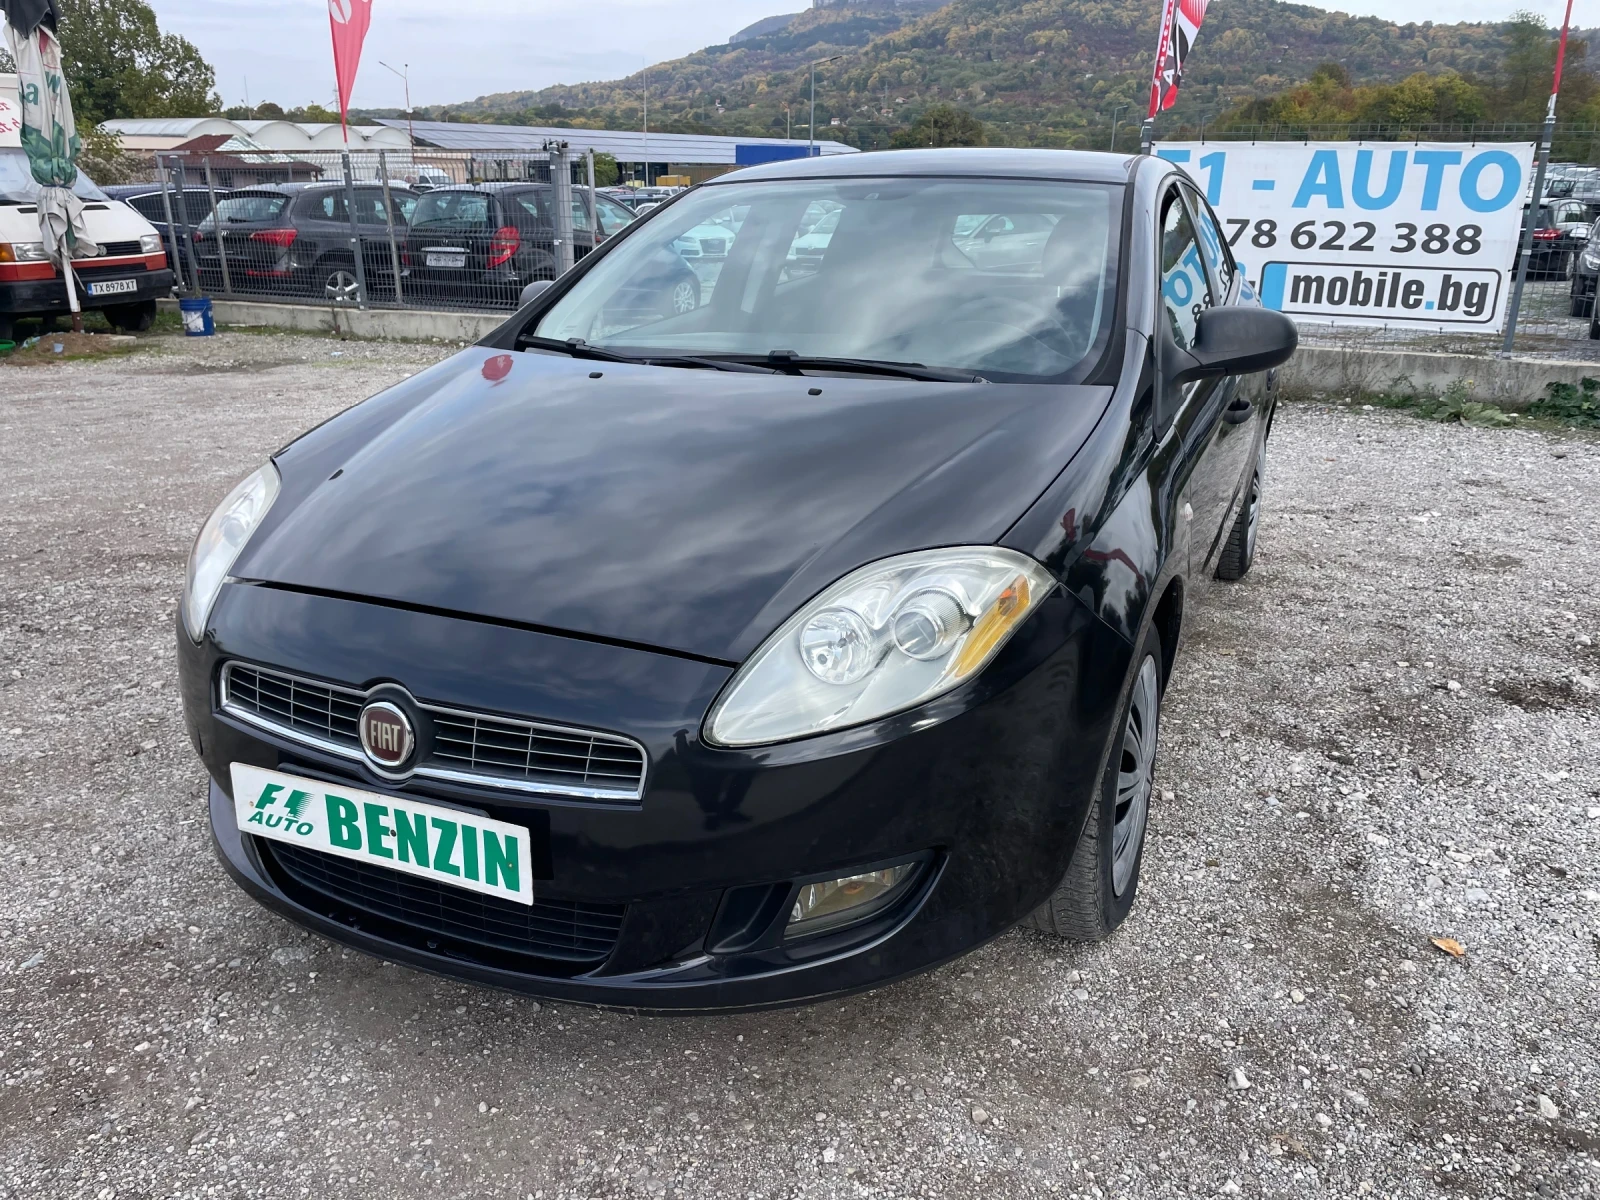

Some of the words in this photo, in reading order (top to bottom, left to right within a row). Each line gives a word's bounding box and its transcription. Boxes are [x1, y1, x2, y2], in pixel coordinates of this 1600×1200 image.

[1157, 150, 1226, 206] 1
[1291, 150, 1522, 213] AUTO
[1219, 218, 1277, 248] 78
[1290, 220, 1377, 251] 622
[1389, 222, 1483, 255] 388
[93, 284, 105, 293] TX
[105, 282, 124, 292] 8978
[126, 280, 135, 290] XT
[1290, 271, 1490, 317] mobile.bg
[371, 719, 401, 752] FIAT
[248, 811, 314, 836] AUTO
[325, 794, 520, 892] BENZIN
